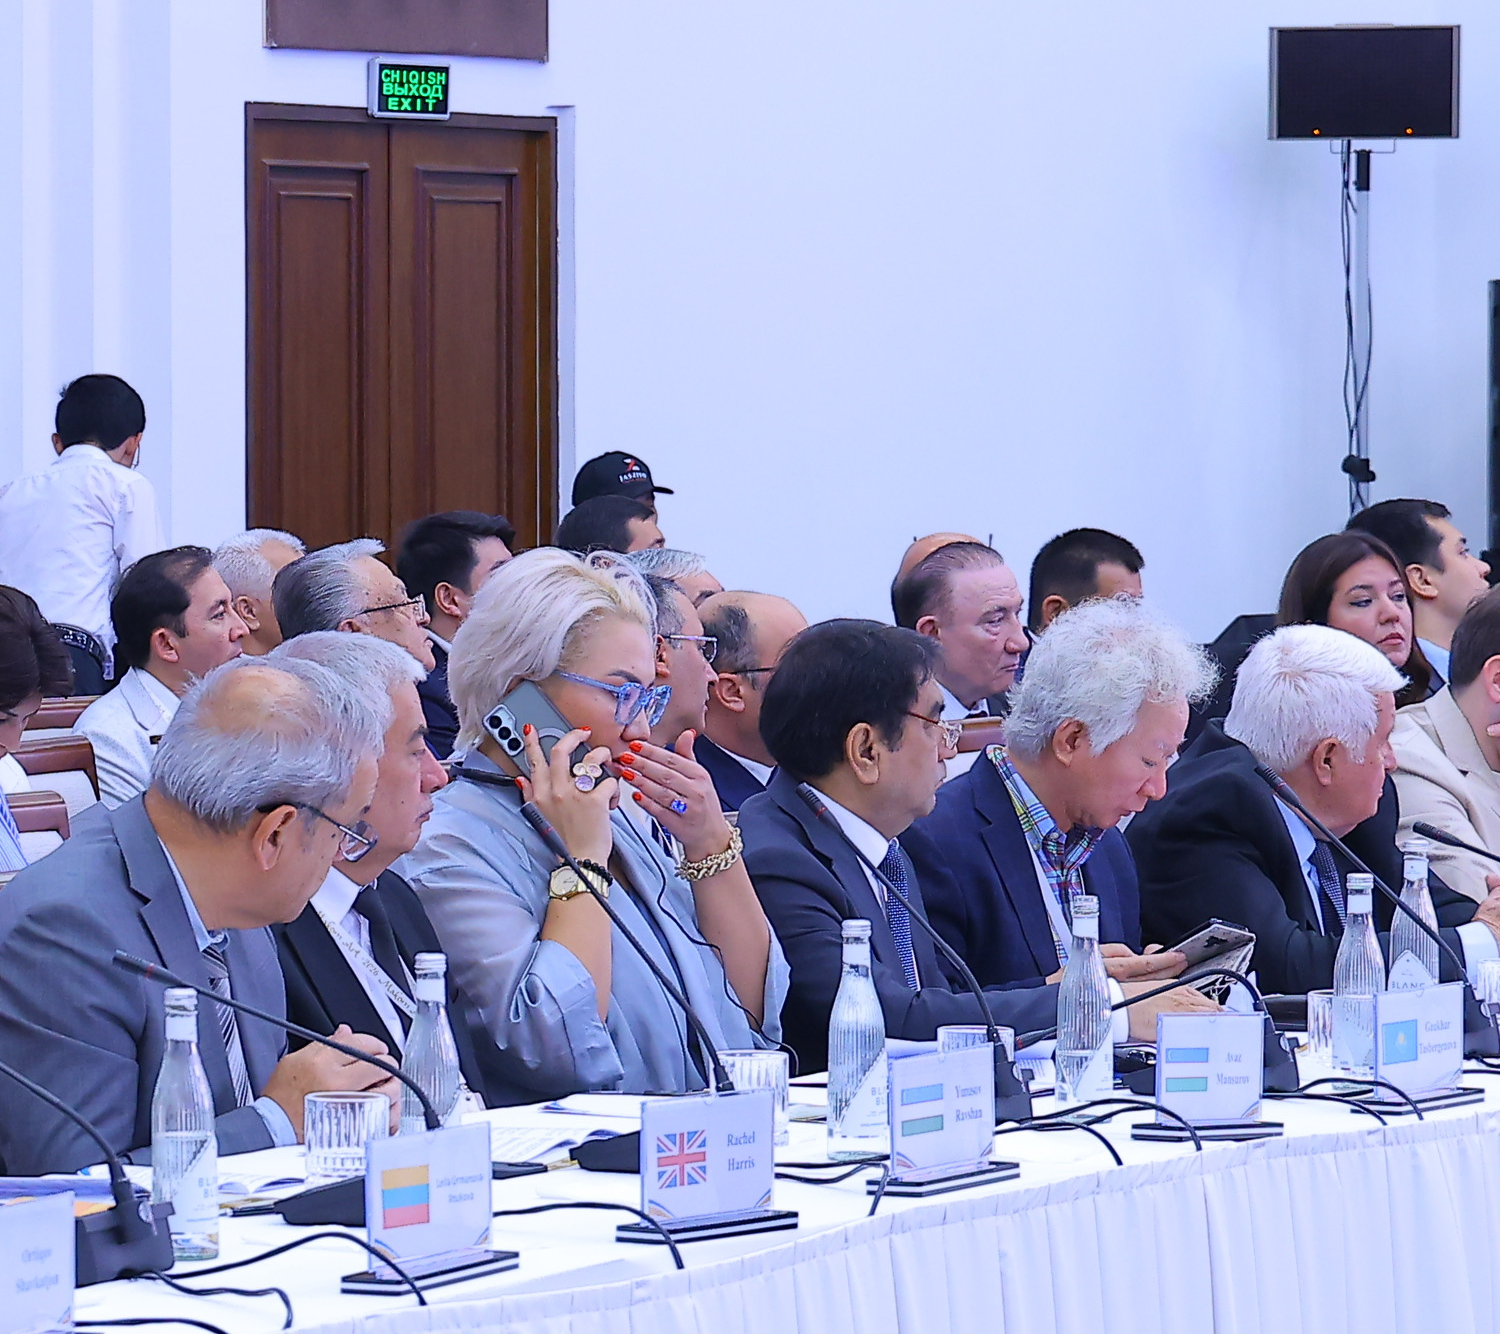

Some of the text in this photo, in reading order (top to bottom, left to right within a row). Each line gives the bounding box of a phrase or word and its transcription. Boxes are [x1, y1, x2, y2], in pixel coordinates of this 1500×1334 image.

[381, 69, 446, 85] CHIQISH
[382, 82, 443, 100] ВЫХОД
[387, 97, 437, 111] EXIT
[727, 1131, 755, 1147] Rachel
[727, 1156, 755, 1171] Harris
